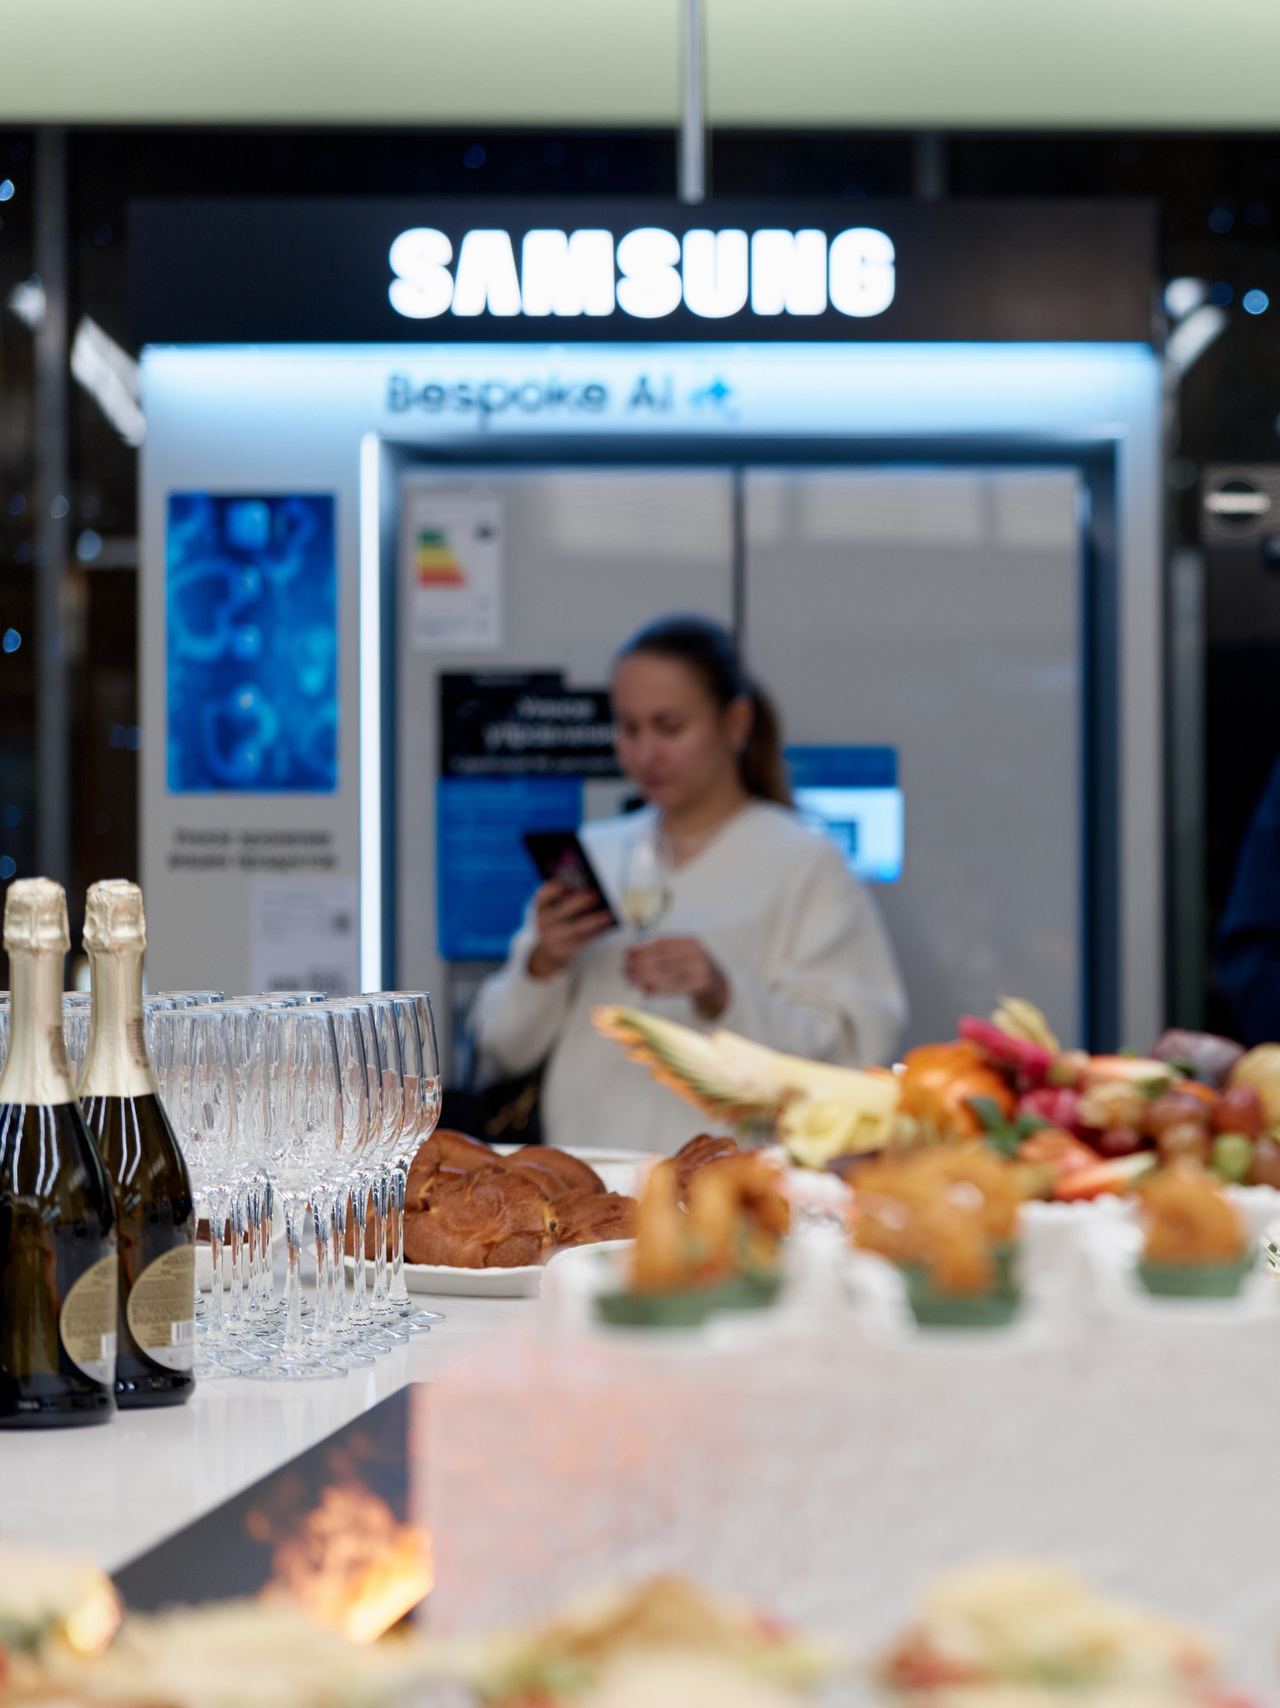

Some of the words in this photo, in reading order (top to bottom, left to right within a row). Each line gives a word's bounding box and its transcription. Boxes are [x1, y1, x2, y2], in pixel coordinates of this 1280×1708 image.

[388, 227, 896, 319] SAMSUNG
[387, 373, 607, 428] Bespoke
[628, 375, 674, 412] AI
